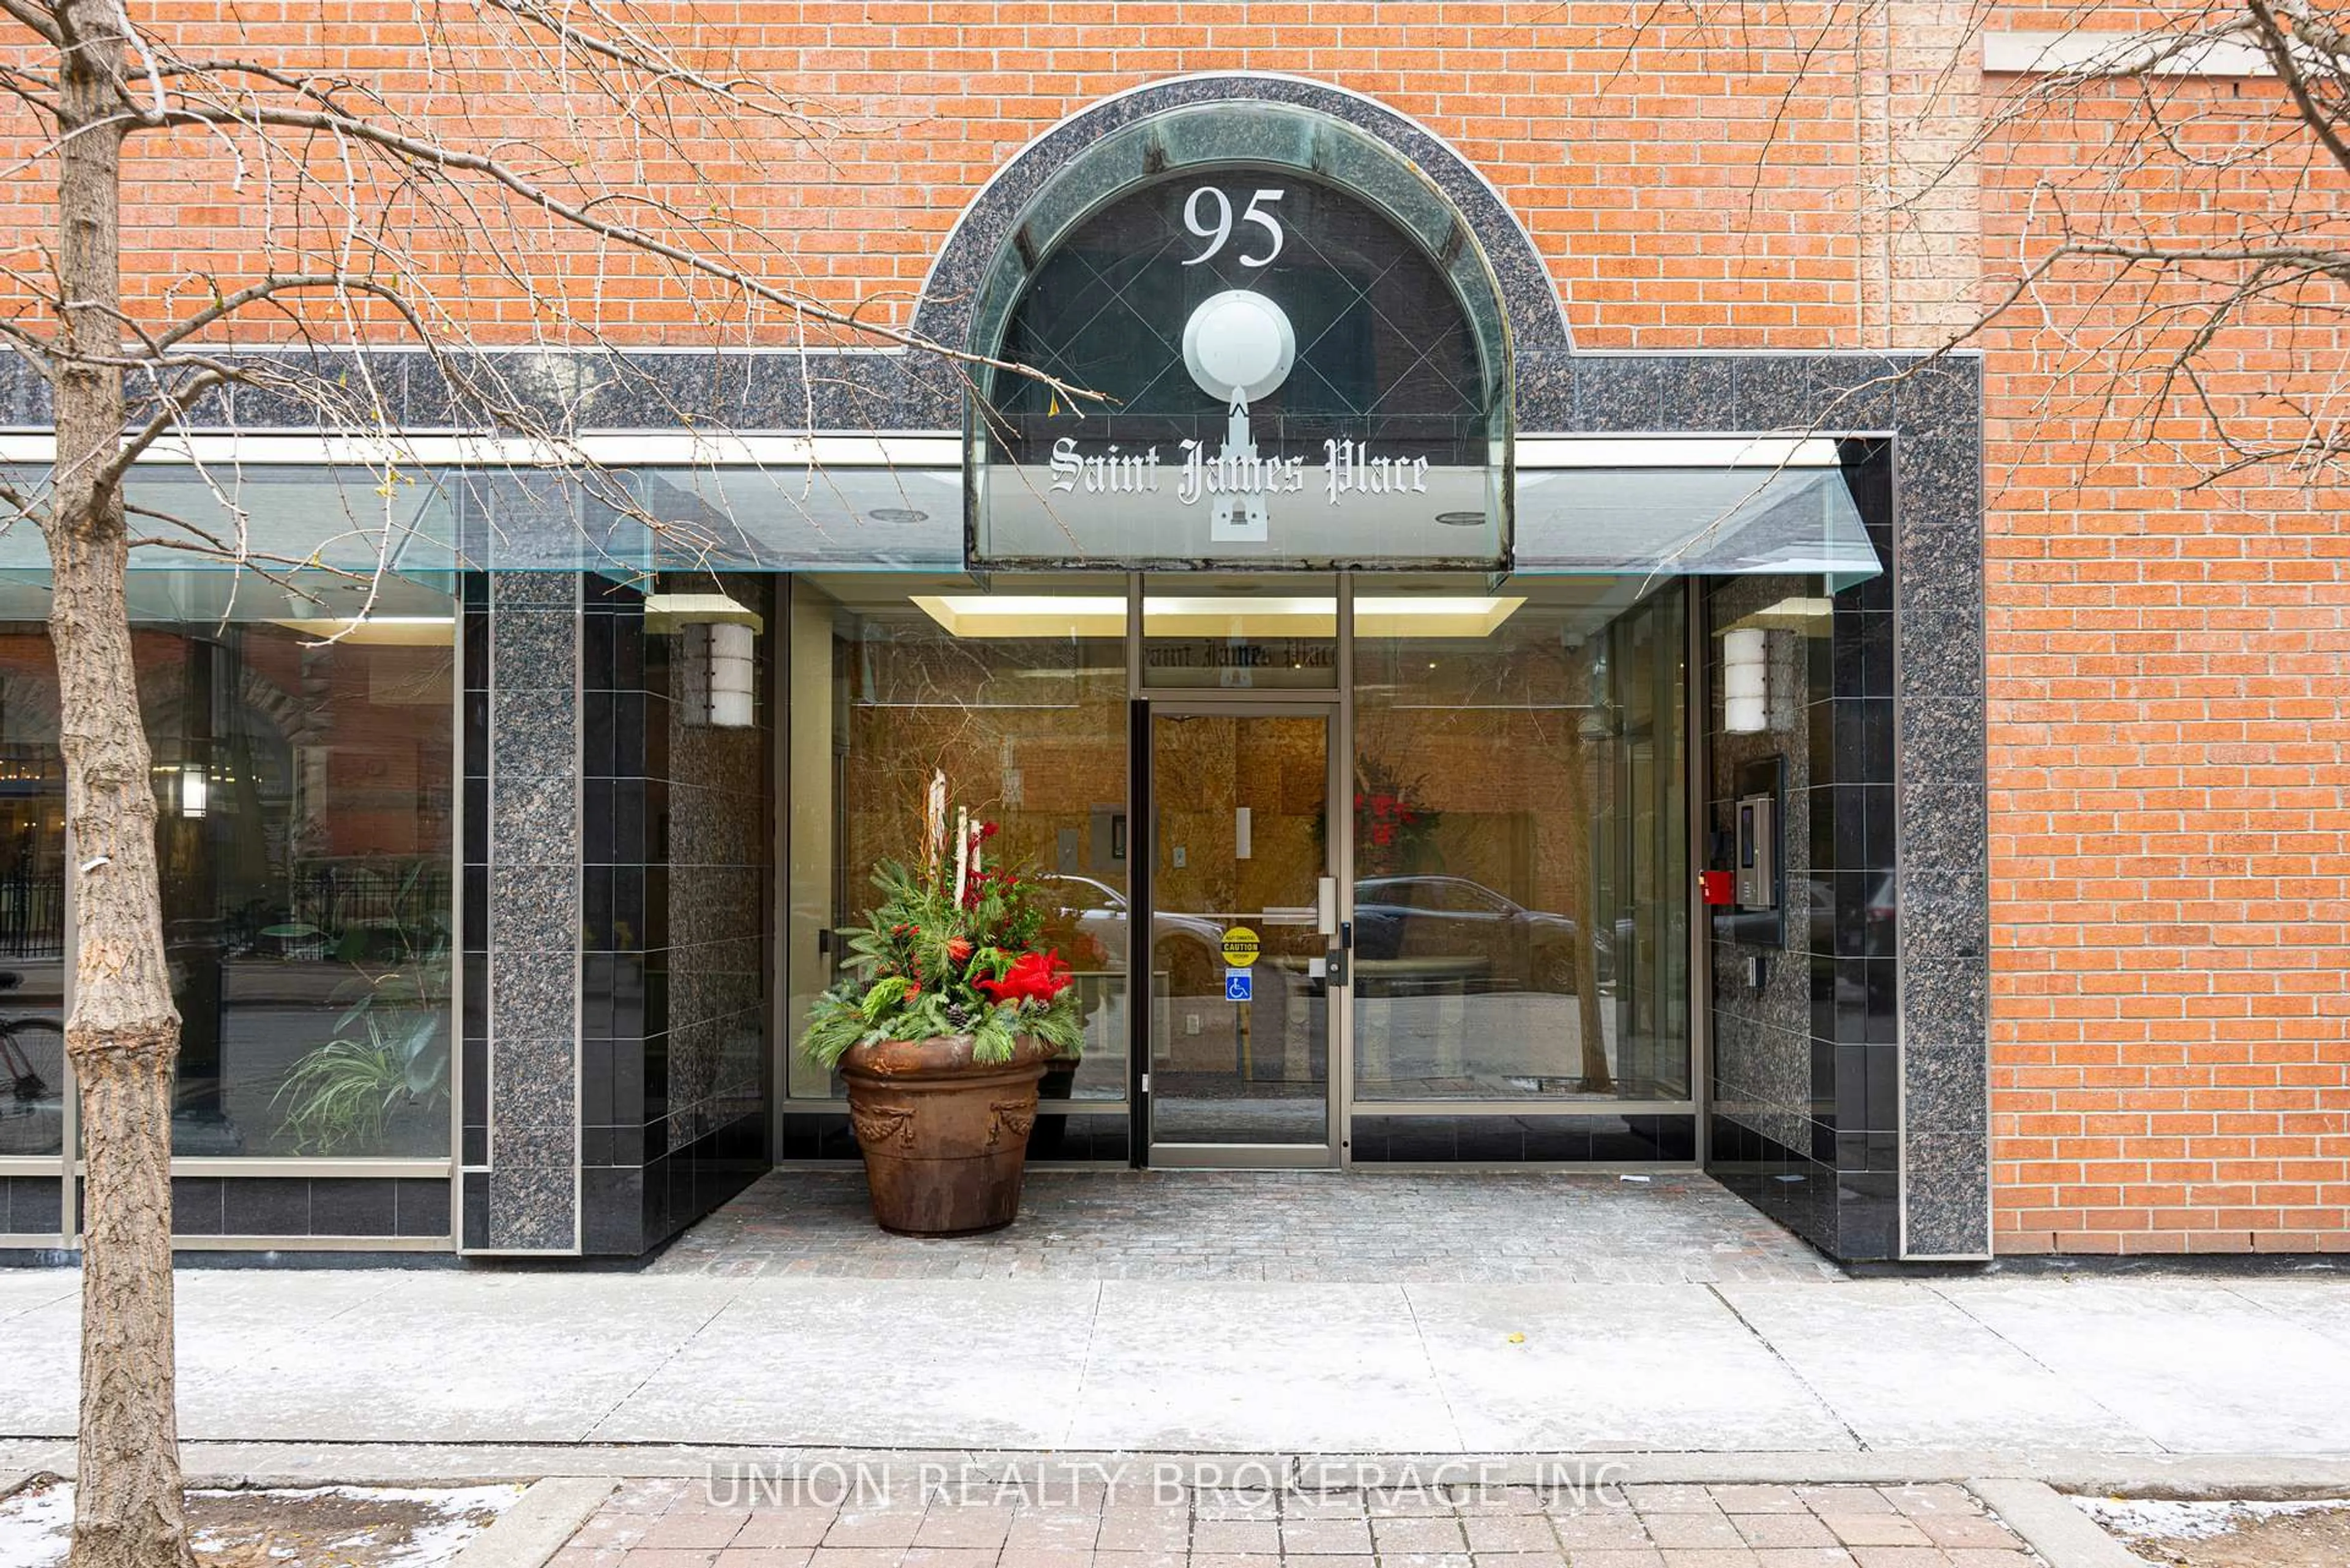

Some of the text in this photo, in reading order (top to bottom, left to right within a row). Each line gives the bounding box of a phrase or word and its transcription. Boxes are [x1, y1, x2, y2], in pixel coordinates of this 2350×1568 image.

[1181, 186, 1285, 267] 95
[1050, 437, 1430, 506] Saint James Place
